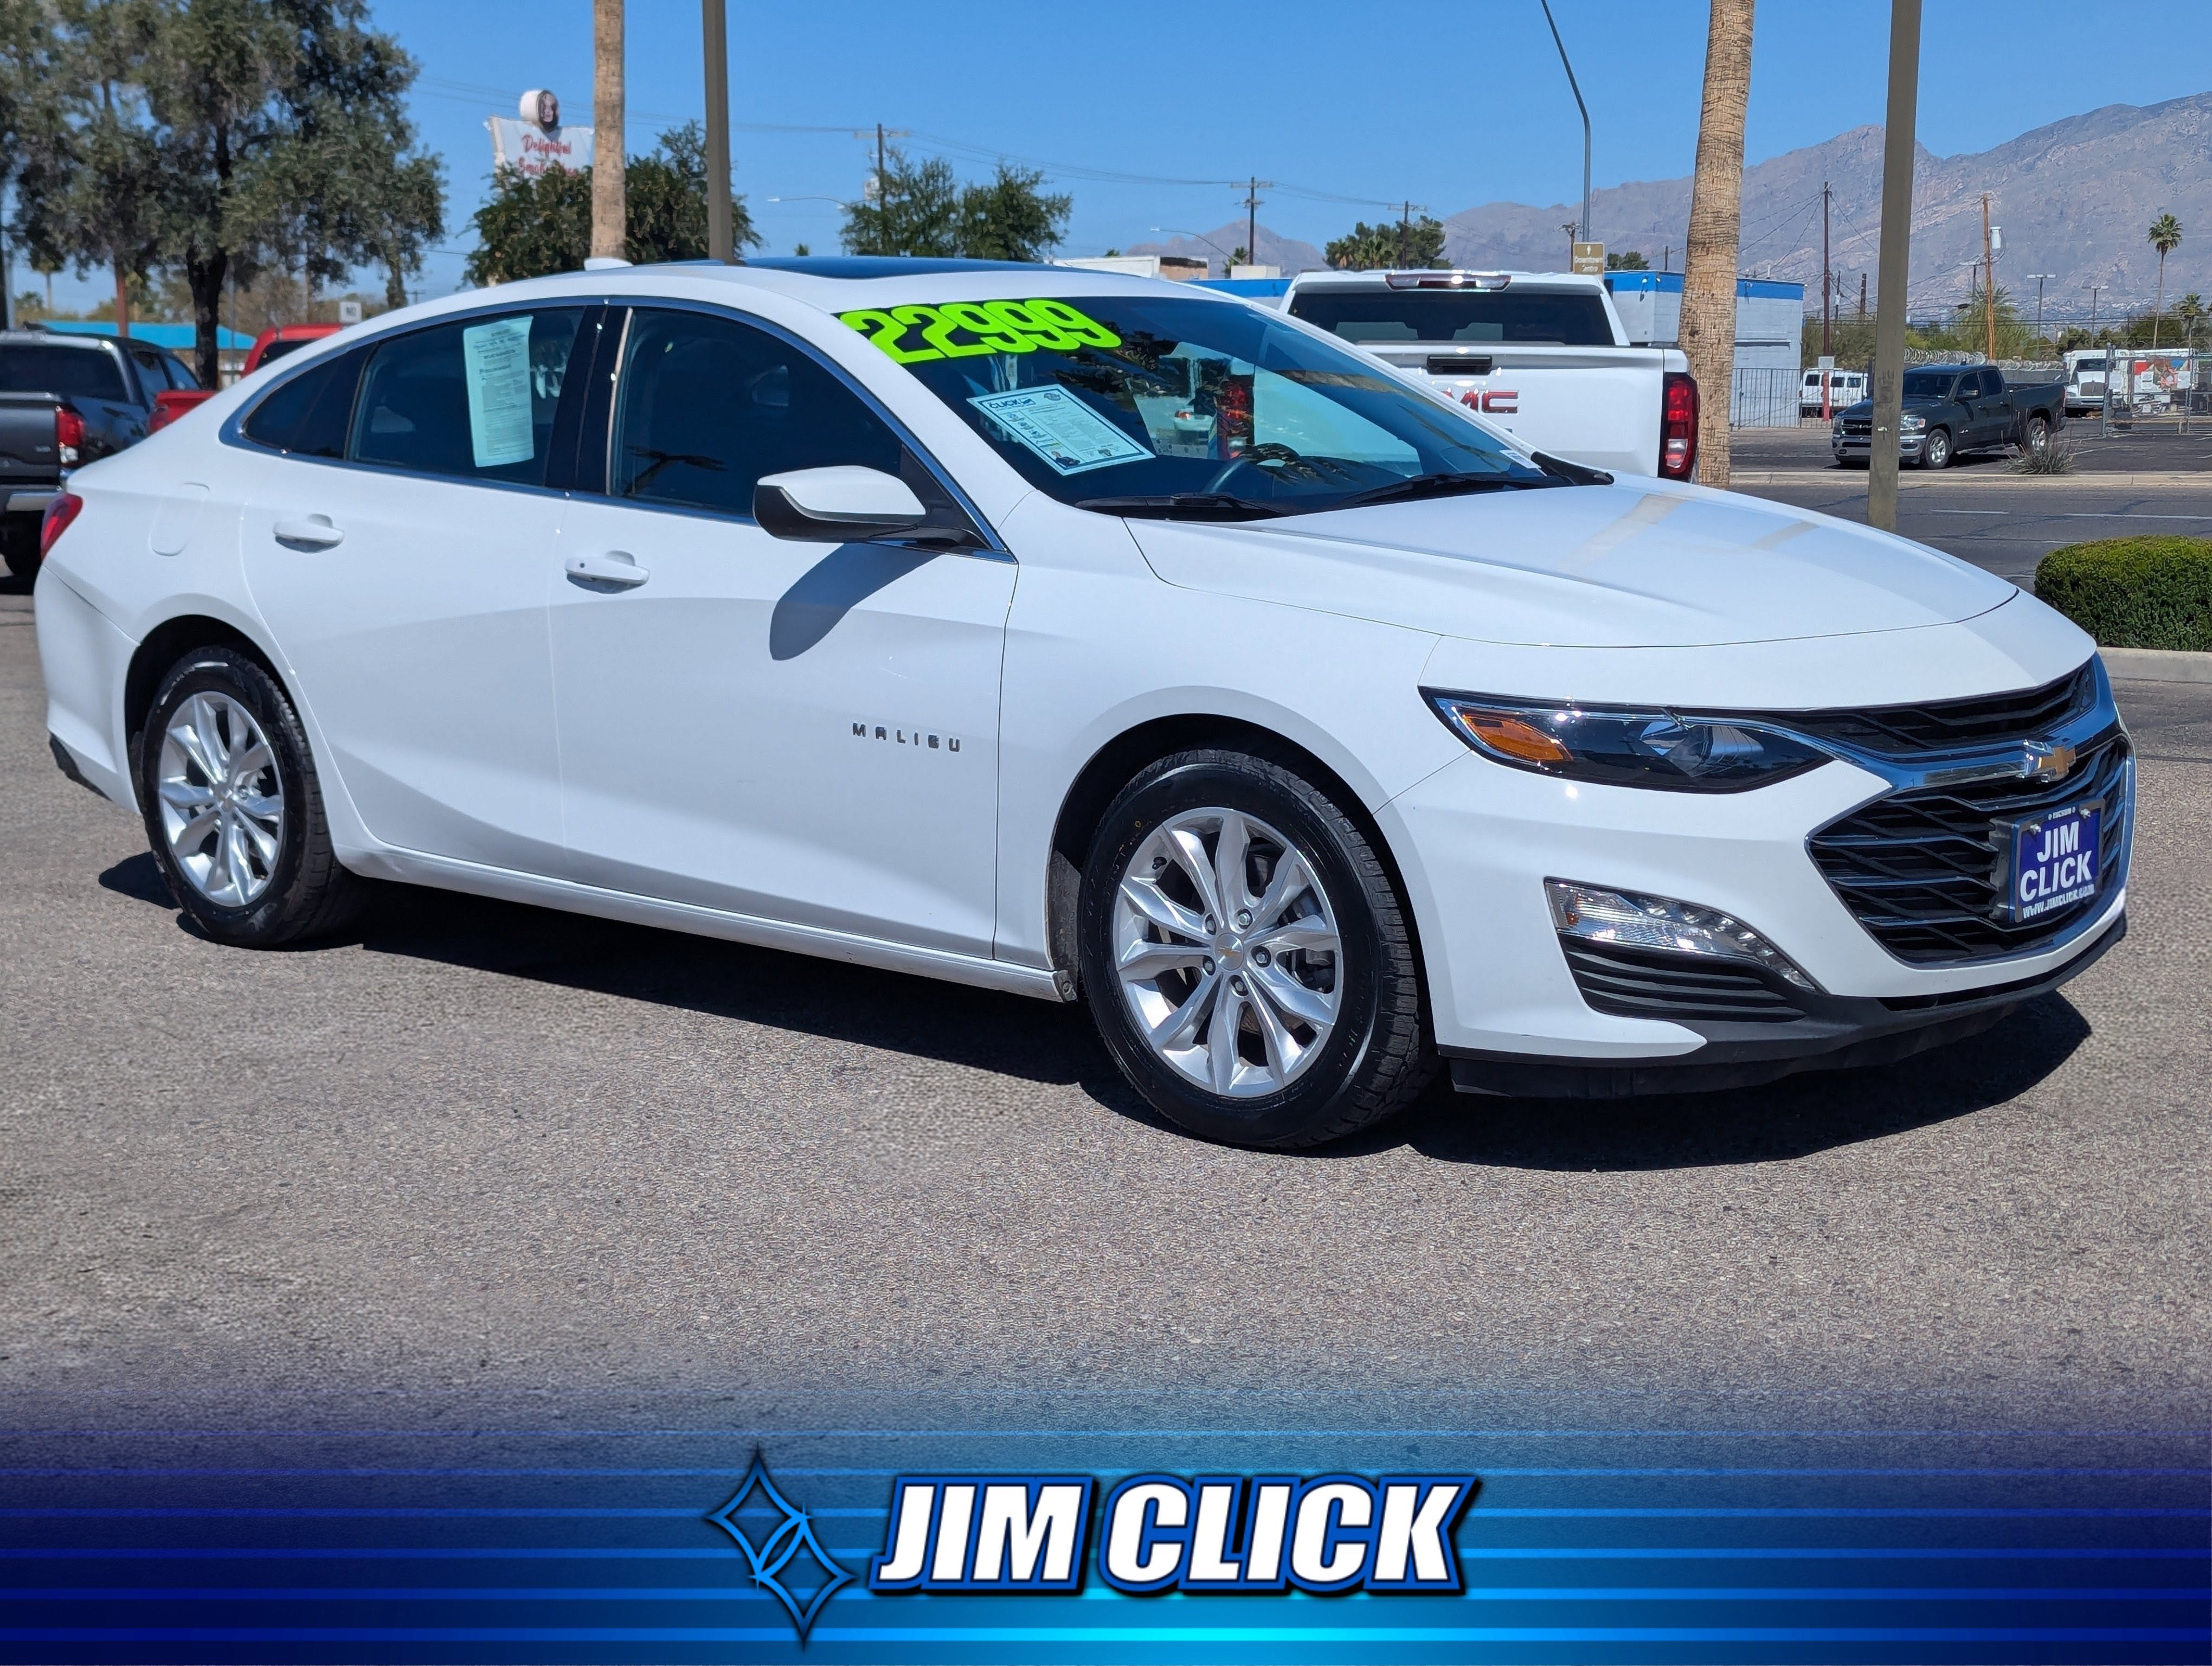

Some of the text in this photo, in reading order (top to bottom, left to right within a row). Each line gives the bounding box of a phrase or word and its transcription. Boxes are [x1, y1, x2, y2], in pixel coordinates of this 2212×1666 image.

[839, 298, 1122, 365] 22999
[1443, 389, 1518, 414] MC
[852, 722, 961, 753] MALIBU
[2036, 821, 2080, 862] JIM
[2020, 850, 2093, 902] CLICK
